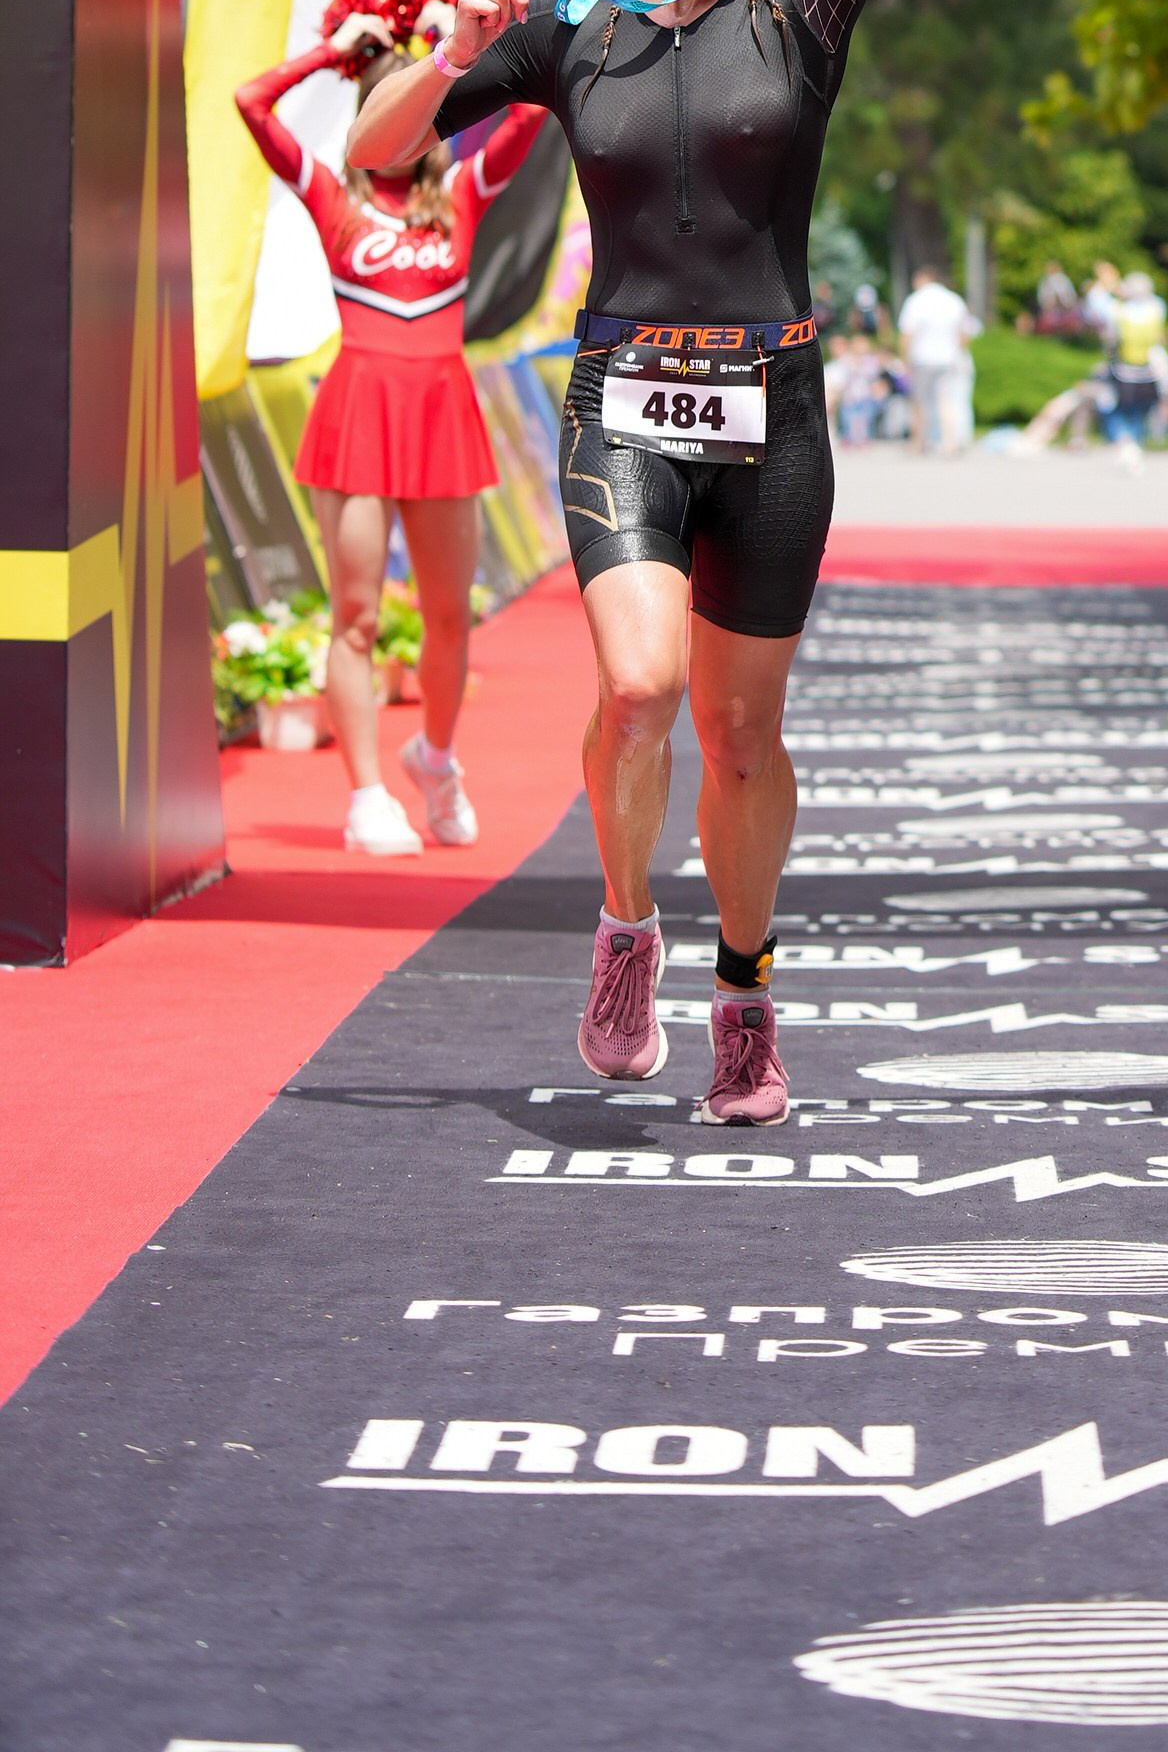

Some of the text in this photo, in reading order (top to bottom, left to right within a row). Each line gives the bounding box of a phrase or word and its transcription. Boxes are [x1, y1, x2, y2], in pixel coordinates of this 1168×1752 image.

[352, 229, 457, 277] Cool
[630, 324, 746, 349] ZONE3
[779, 317, 817, 347] ZO
[660, 355, 711, 371] IRON STAR
[642, 391, 726, 431] 484
[660, 439, 704, 455] MARIYA
[502, 1149, 919, 1180] IRON
[346, 1418, 916, 1479] IRON
